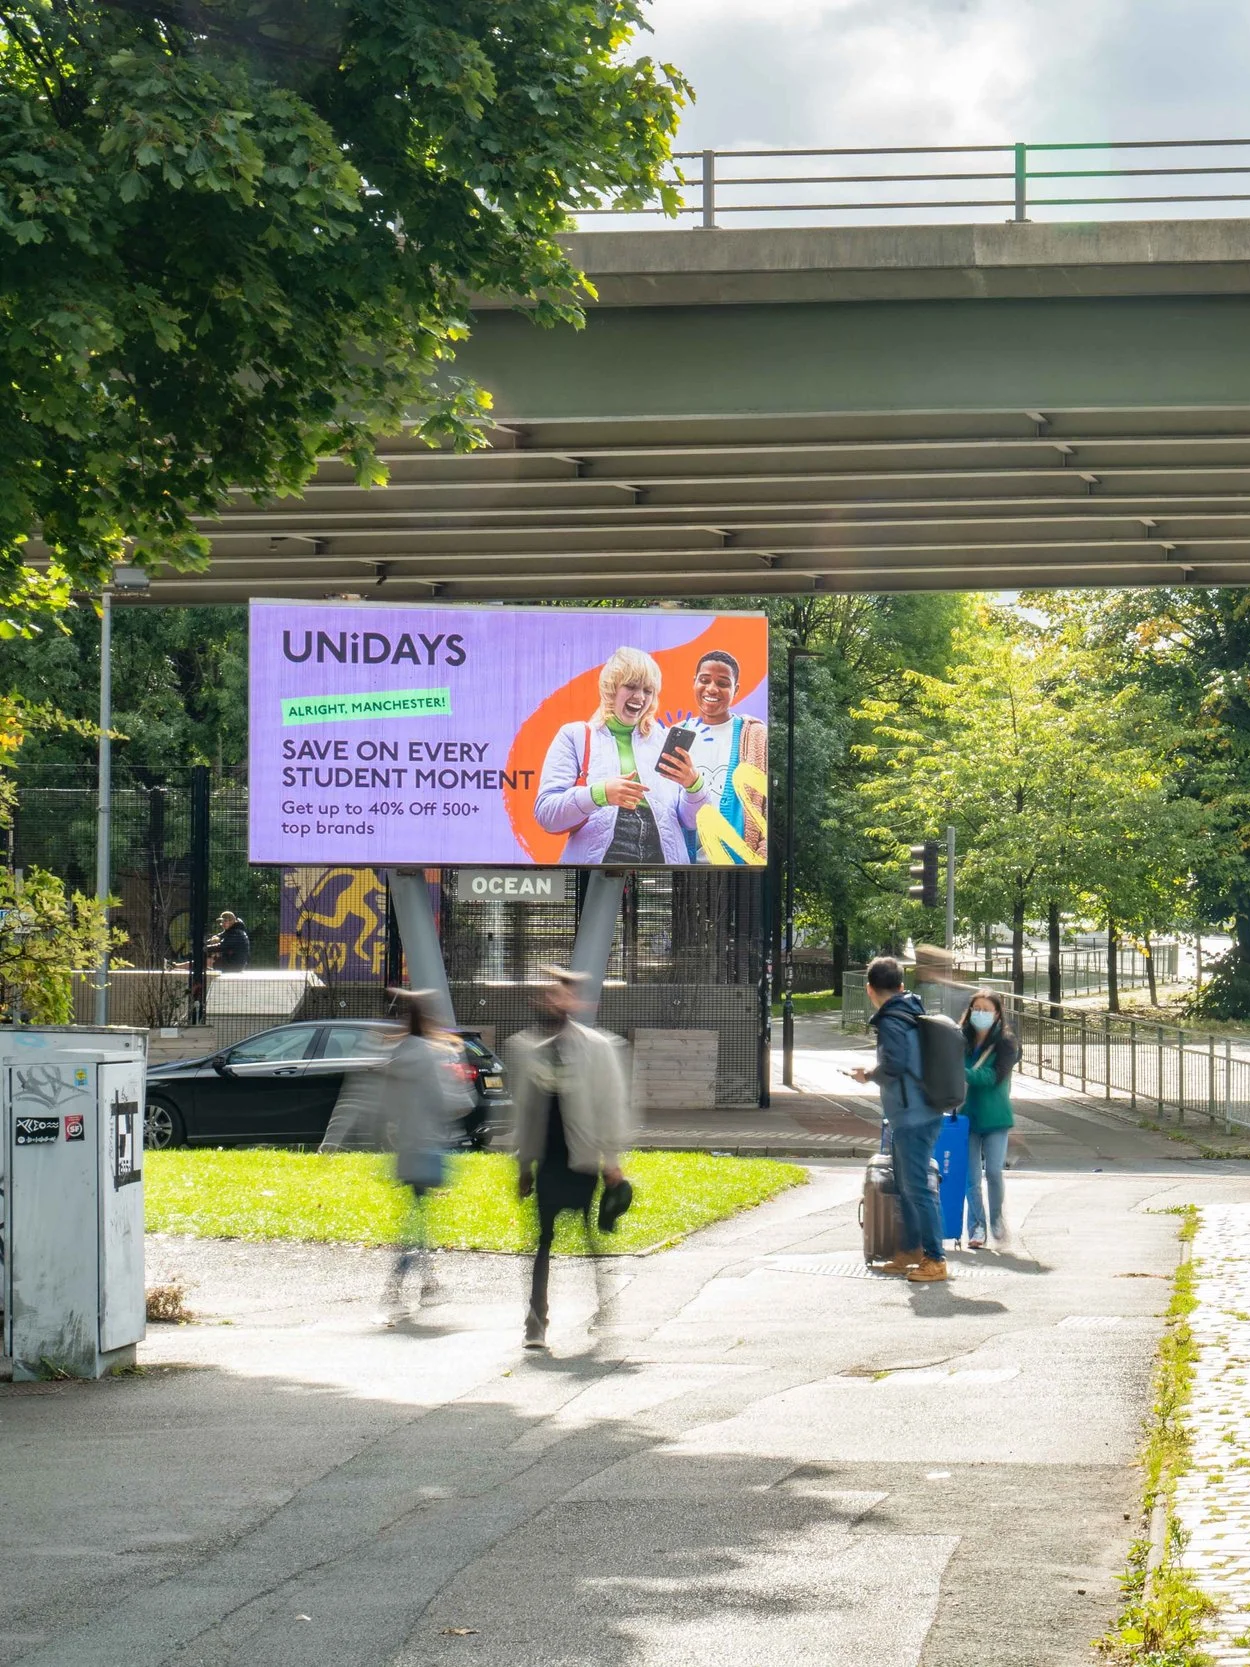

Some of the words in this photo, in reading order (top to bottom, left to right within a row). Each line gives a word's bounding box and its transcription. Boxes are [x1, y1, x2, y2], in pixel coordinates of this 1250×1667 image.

[288, 703, 348, 717] ALRIGHT,
[351, 697, 446, 713] MANCHESTER!
[282, 739, 349, 761] SAVE
[356, 740, 399, 762] ON
[408, 741, 490, 763] EVERY
[282, 766, 408, 789] STUDENT
[415, 768, 535, 790] MOMENT
[281, 800, 314, 815] Get
[318, 804, 340, 819] up
[344, 803, 363, 815] to
[368, 801, 405, 816] 40%
[409, 802, 437, 816] Off
[442, 802, 480, 817] 500+
[281, 822, 311, 838] top
[316, 820, 375, 835] brands
[471, 876, 552, 895] OCEAN
